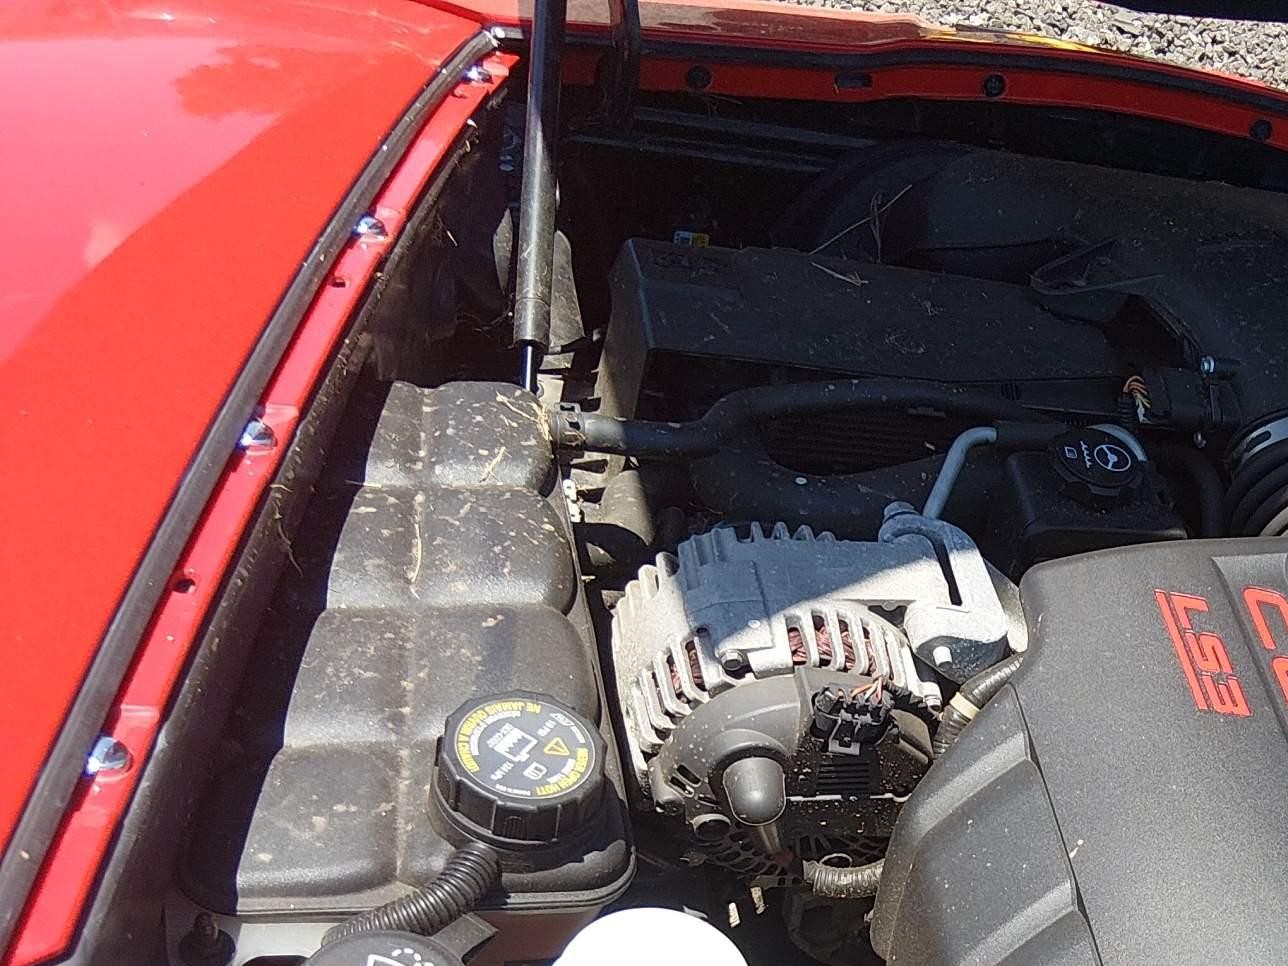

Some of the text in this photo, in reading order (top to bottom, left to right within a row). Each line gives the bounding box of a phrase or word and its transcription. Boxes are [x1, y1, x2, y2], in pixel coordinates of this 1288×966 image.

[1155, 588, 1253, 716] LS3
[484, 701, 526, 715] JAMAIS
[526, 702, 541, 714] NE
[460, 709, 489, 735] OUVRIR
[558, 771, 582, 789] OPEN
